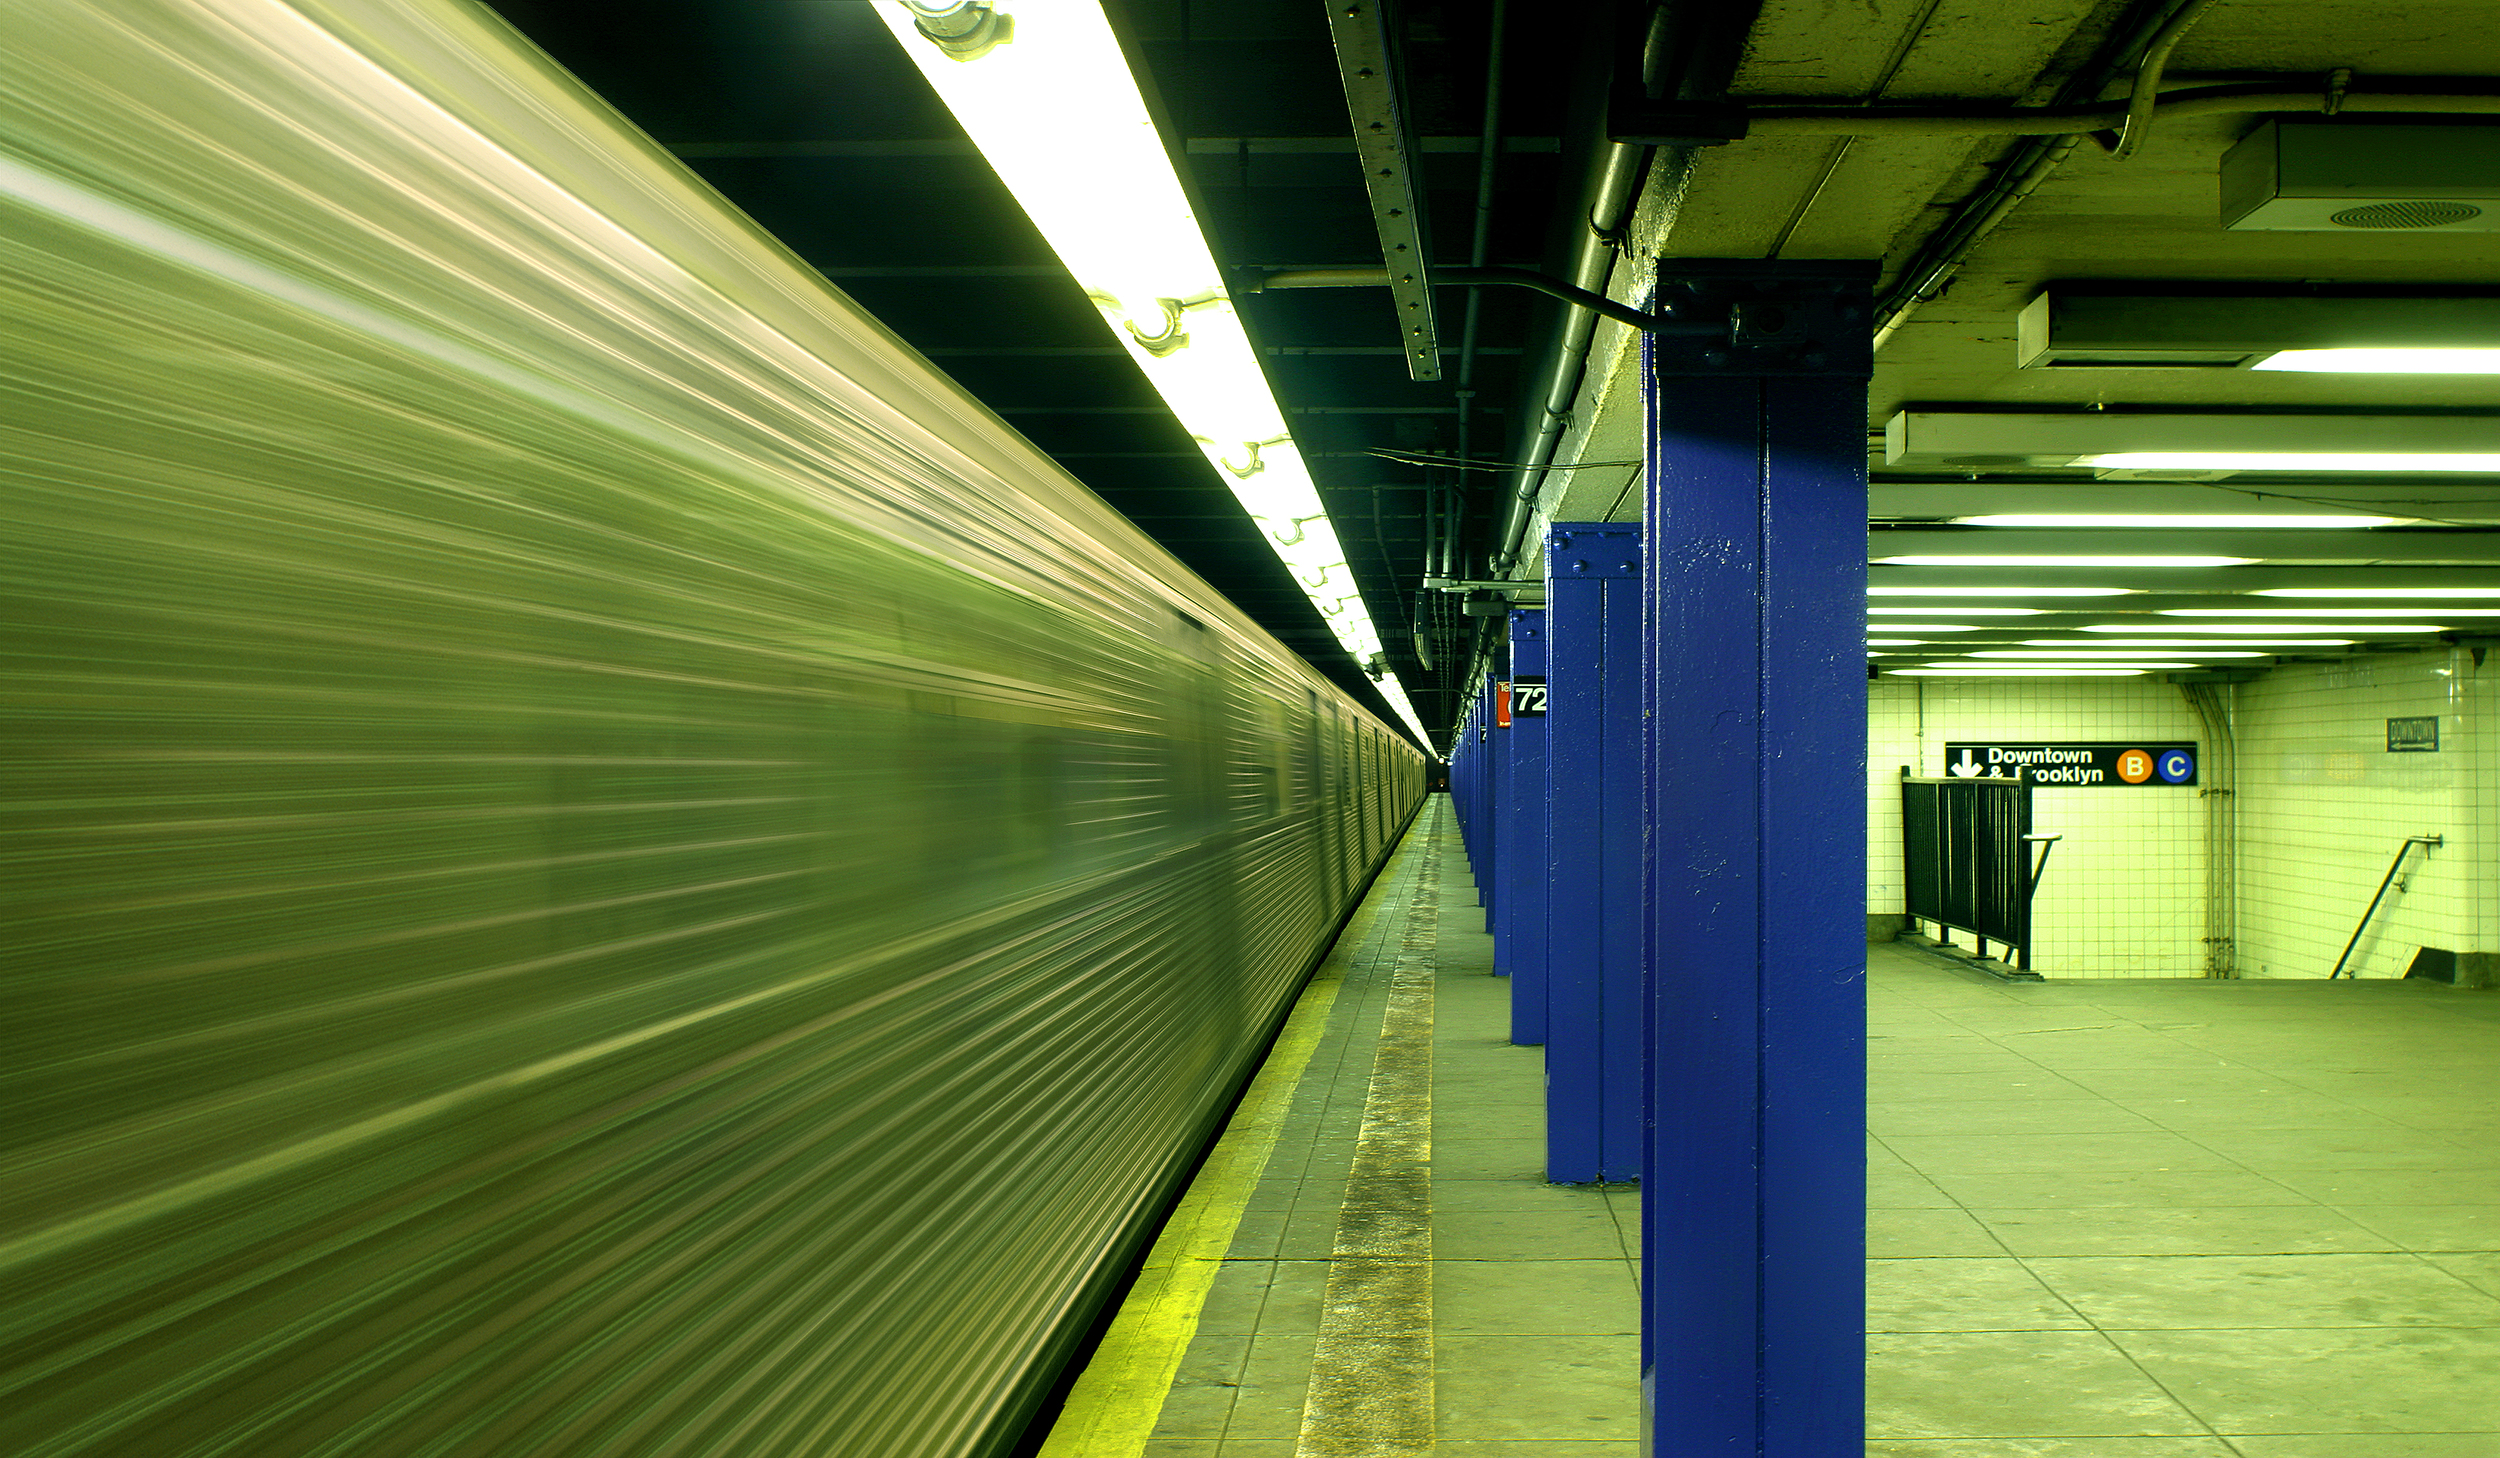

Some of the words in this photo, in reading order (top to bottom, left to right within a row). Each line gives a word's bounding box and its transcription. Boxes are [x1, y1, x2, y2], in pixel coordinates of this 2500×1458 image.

[1515, 687, 1547, 711] 72
[1988, 747, 2093, 764] Downtown
[2014, 765, 2104, 786] ooklyn
[2127, 756, 2144, 776] B
[2167, 756, 2186, 776] C
